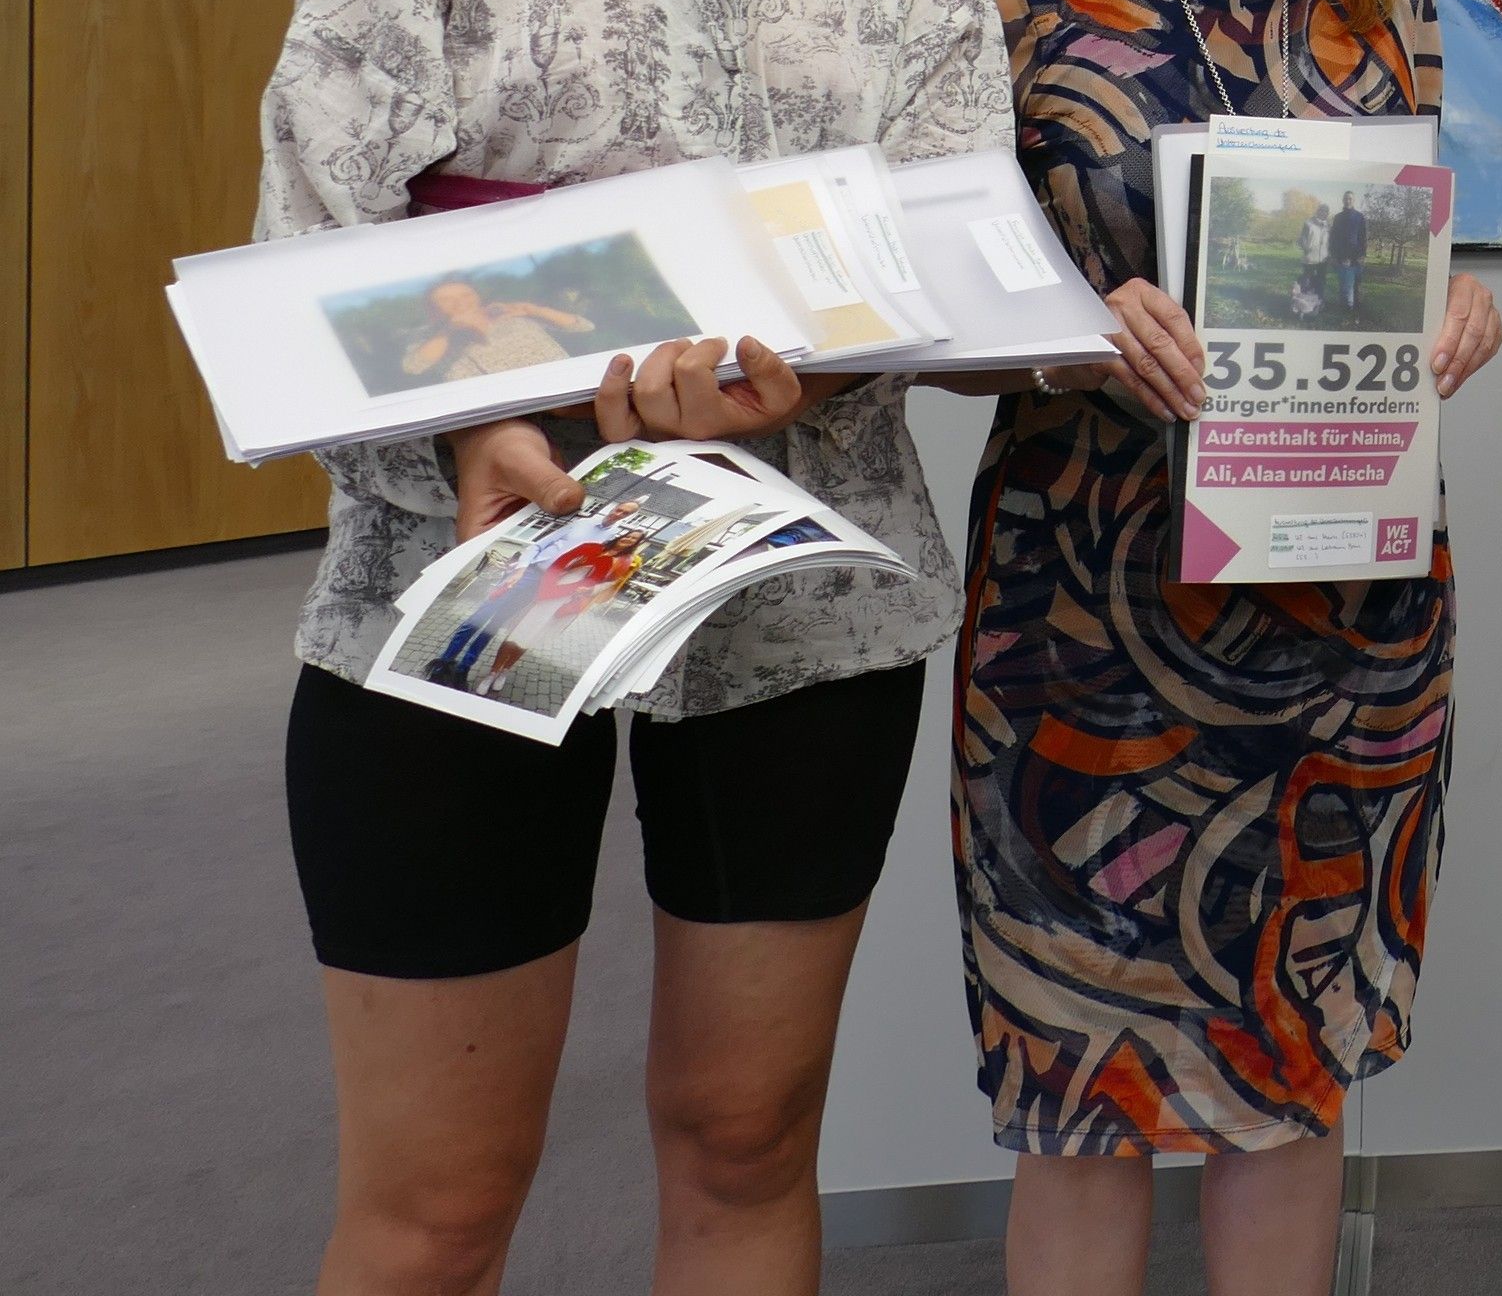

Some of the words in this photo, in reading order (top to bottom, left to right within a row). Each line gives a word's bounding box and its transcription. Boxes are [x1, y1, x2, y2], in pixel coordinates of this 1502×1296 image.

[1202, 341, 1421, 392] 35.528
[1205, 427, 1317, 446] Aufenthalt
[1321, 428, 1348, 446] für
[1352, 429, 1405, 448] Naima,
[1203, 465, 1237, 485] Ali,
[1241, 465, 1285, 482] Alaa
[1290, 465, 1325, 482] und
[1329, 465, 1385, 481] Aischa
[1386, 524, 1409, 540] WE
